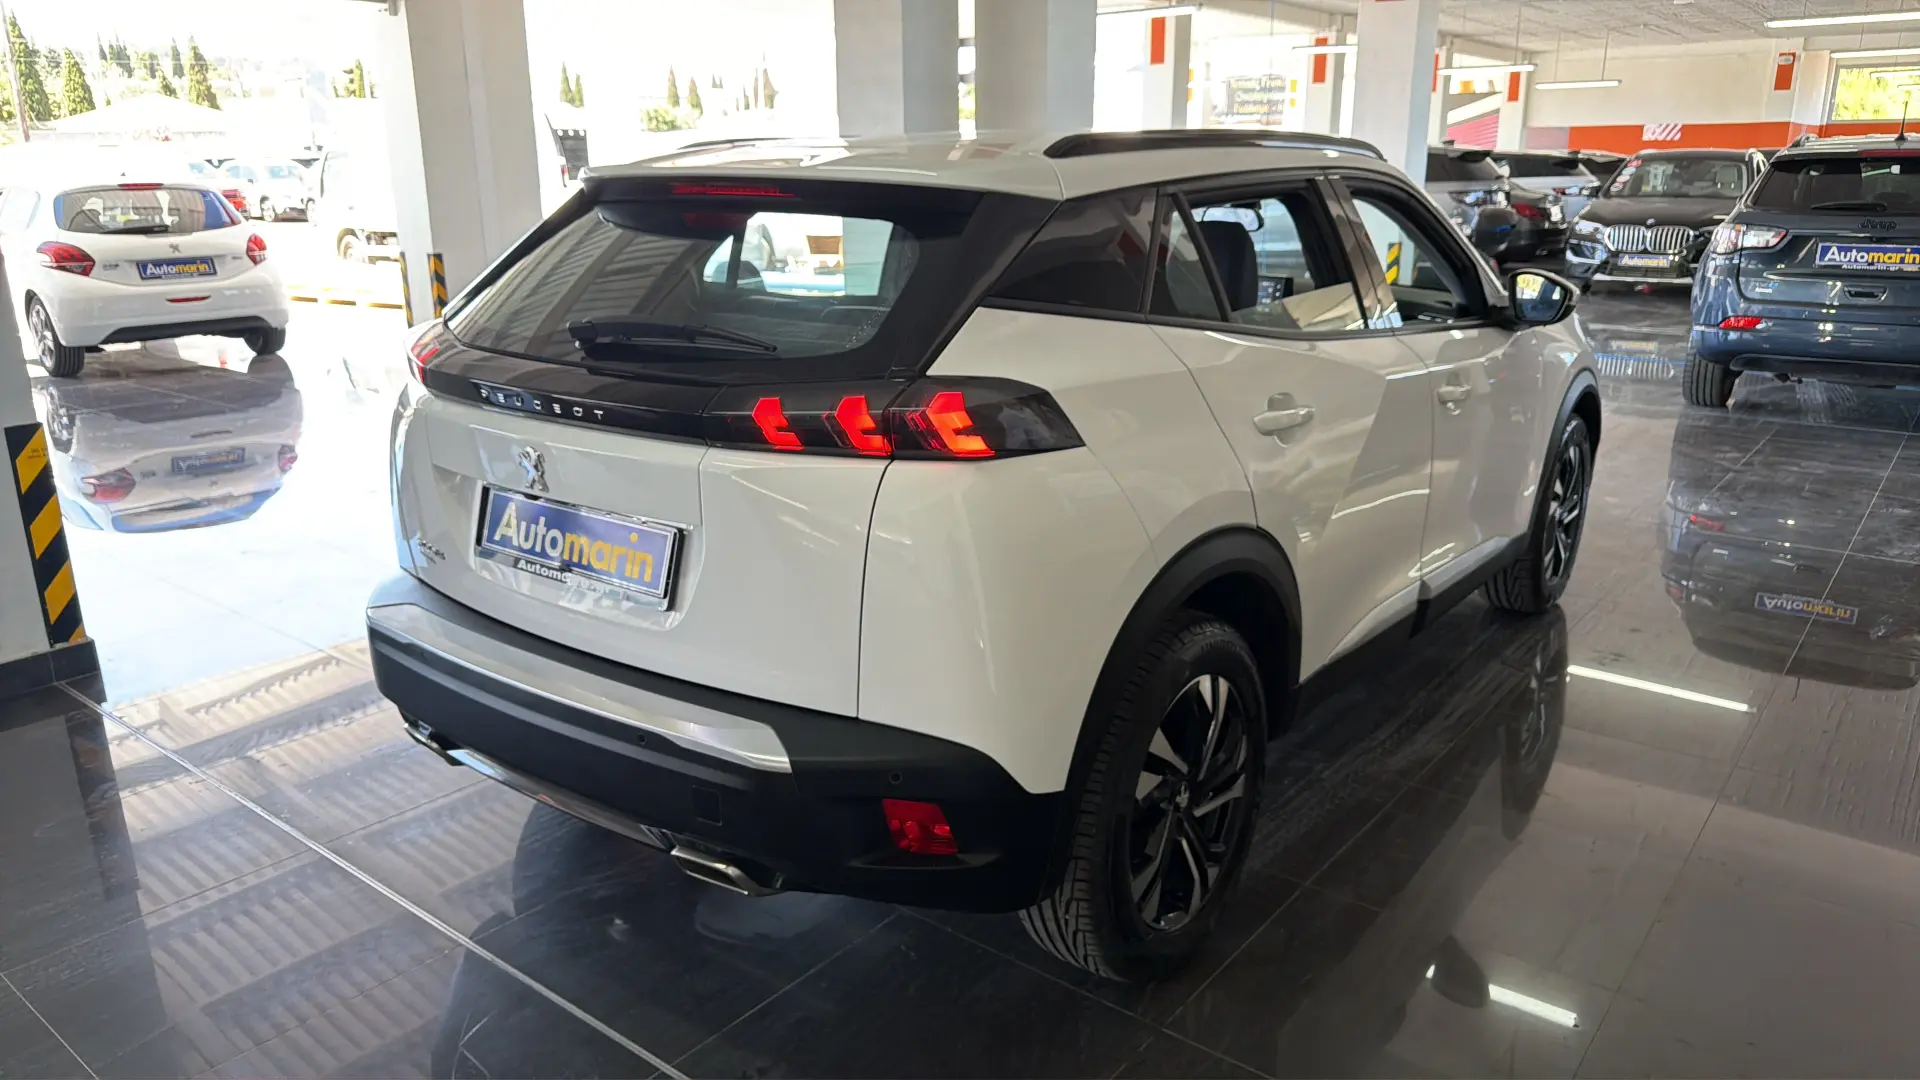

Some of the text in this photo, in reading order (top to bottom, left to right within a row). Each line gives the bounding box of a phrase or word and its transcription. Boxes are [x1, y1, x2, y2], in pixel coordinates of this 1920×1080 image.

[1824, 246, 1920, 264] Automarin
[146, 260, 209, 276] Automarin
[493, 501, 653, 583] Automarin
